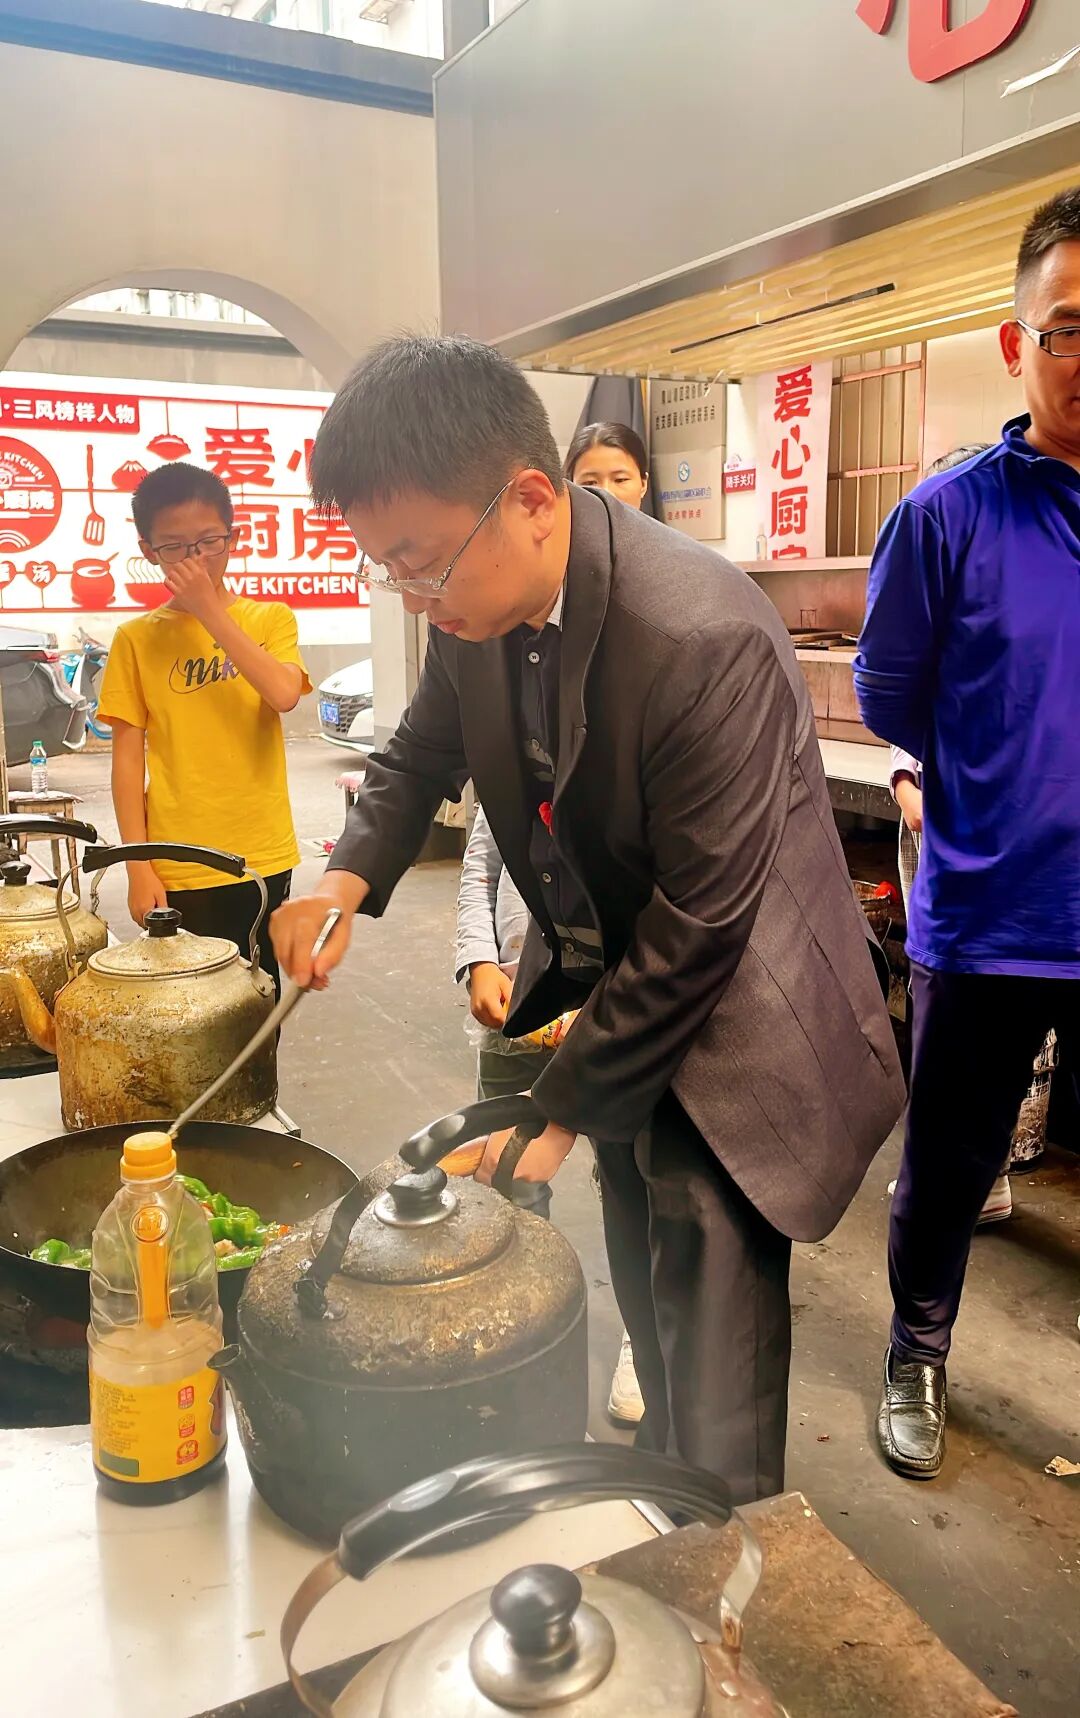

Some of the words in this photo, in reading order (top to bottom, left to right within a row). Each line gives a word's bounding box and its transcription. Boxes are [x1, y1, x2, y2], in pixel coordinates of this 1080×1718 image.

[0, 398, 136, 424] ·三风榜样人物
[3, 451, 45, 481] KITCHEN
[725, 473, 755, 489] 随手关灯
[222, 576, 260, 595] VE
[261, 575, 357, 595] KITCHEN
